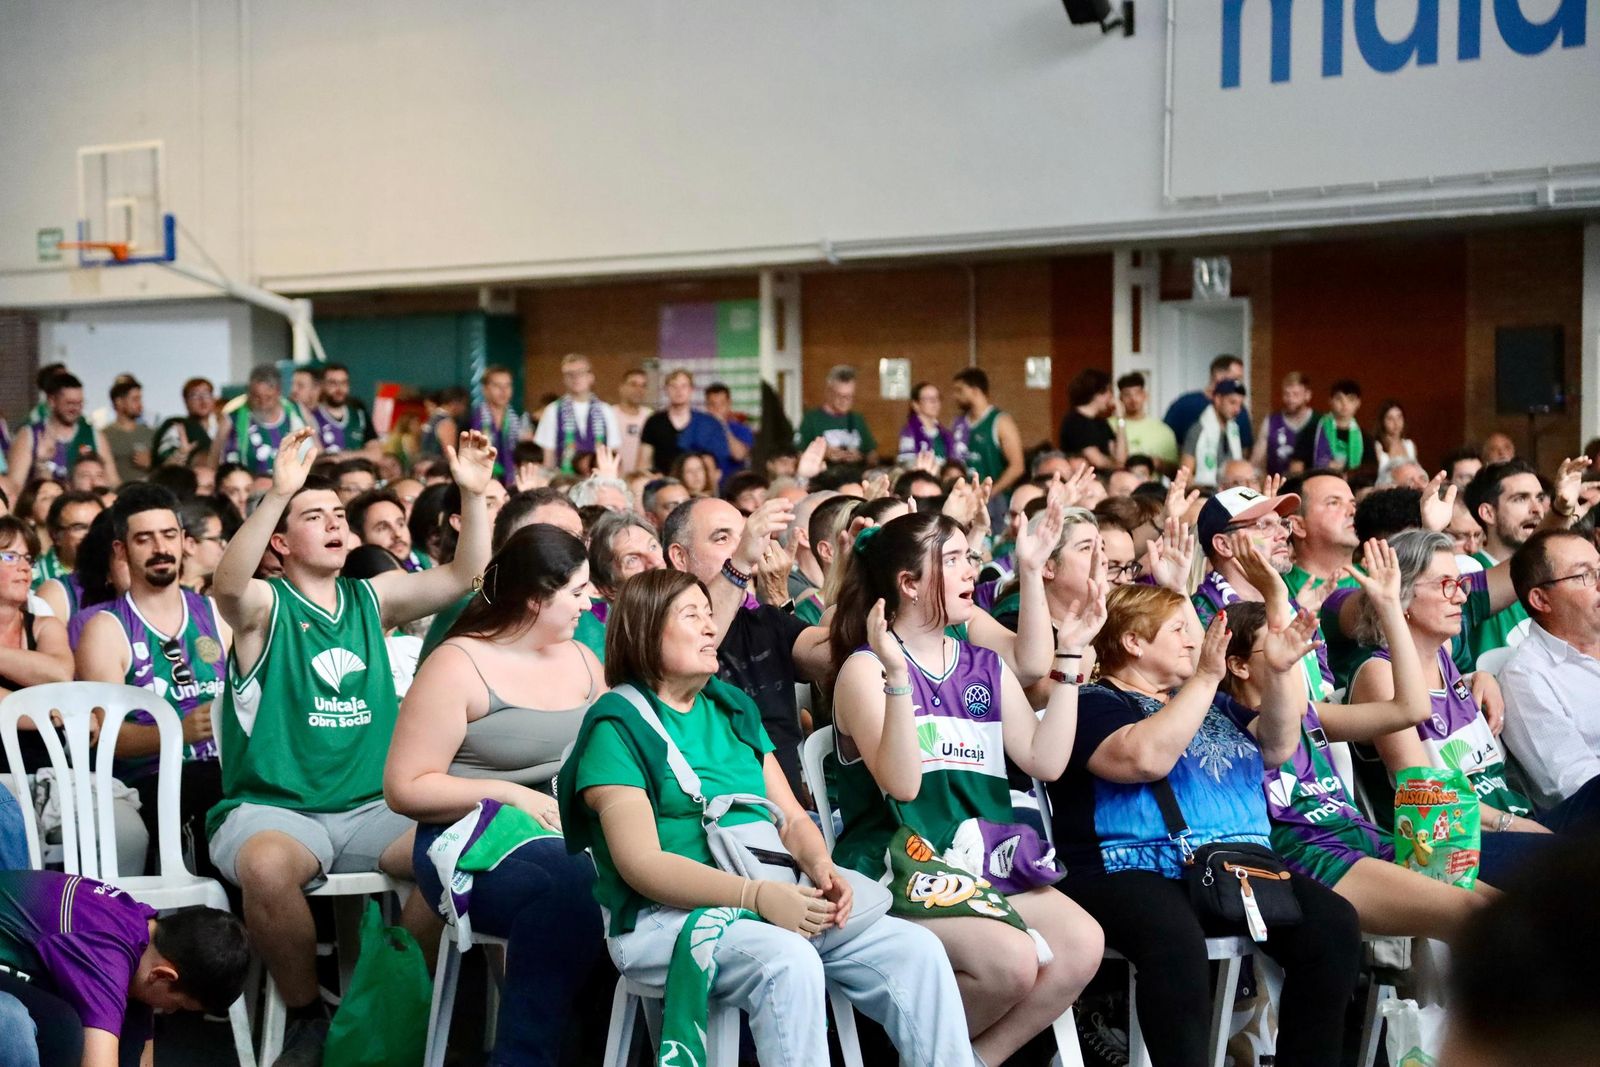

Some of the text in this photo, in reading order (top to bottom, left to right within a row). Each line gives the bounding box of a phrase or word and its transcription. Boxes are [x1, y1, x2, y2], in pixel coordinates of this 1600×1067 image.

[314, 696, 368, 715] Unicaja
[308, 712, 372, 728] Obra Social
[942, 742, 985, 762] Unicaja
